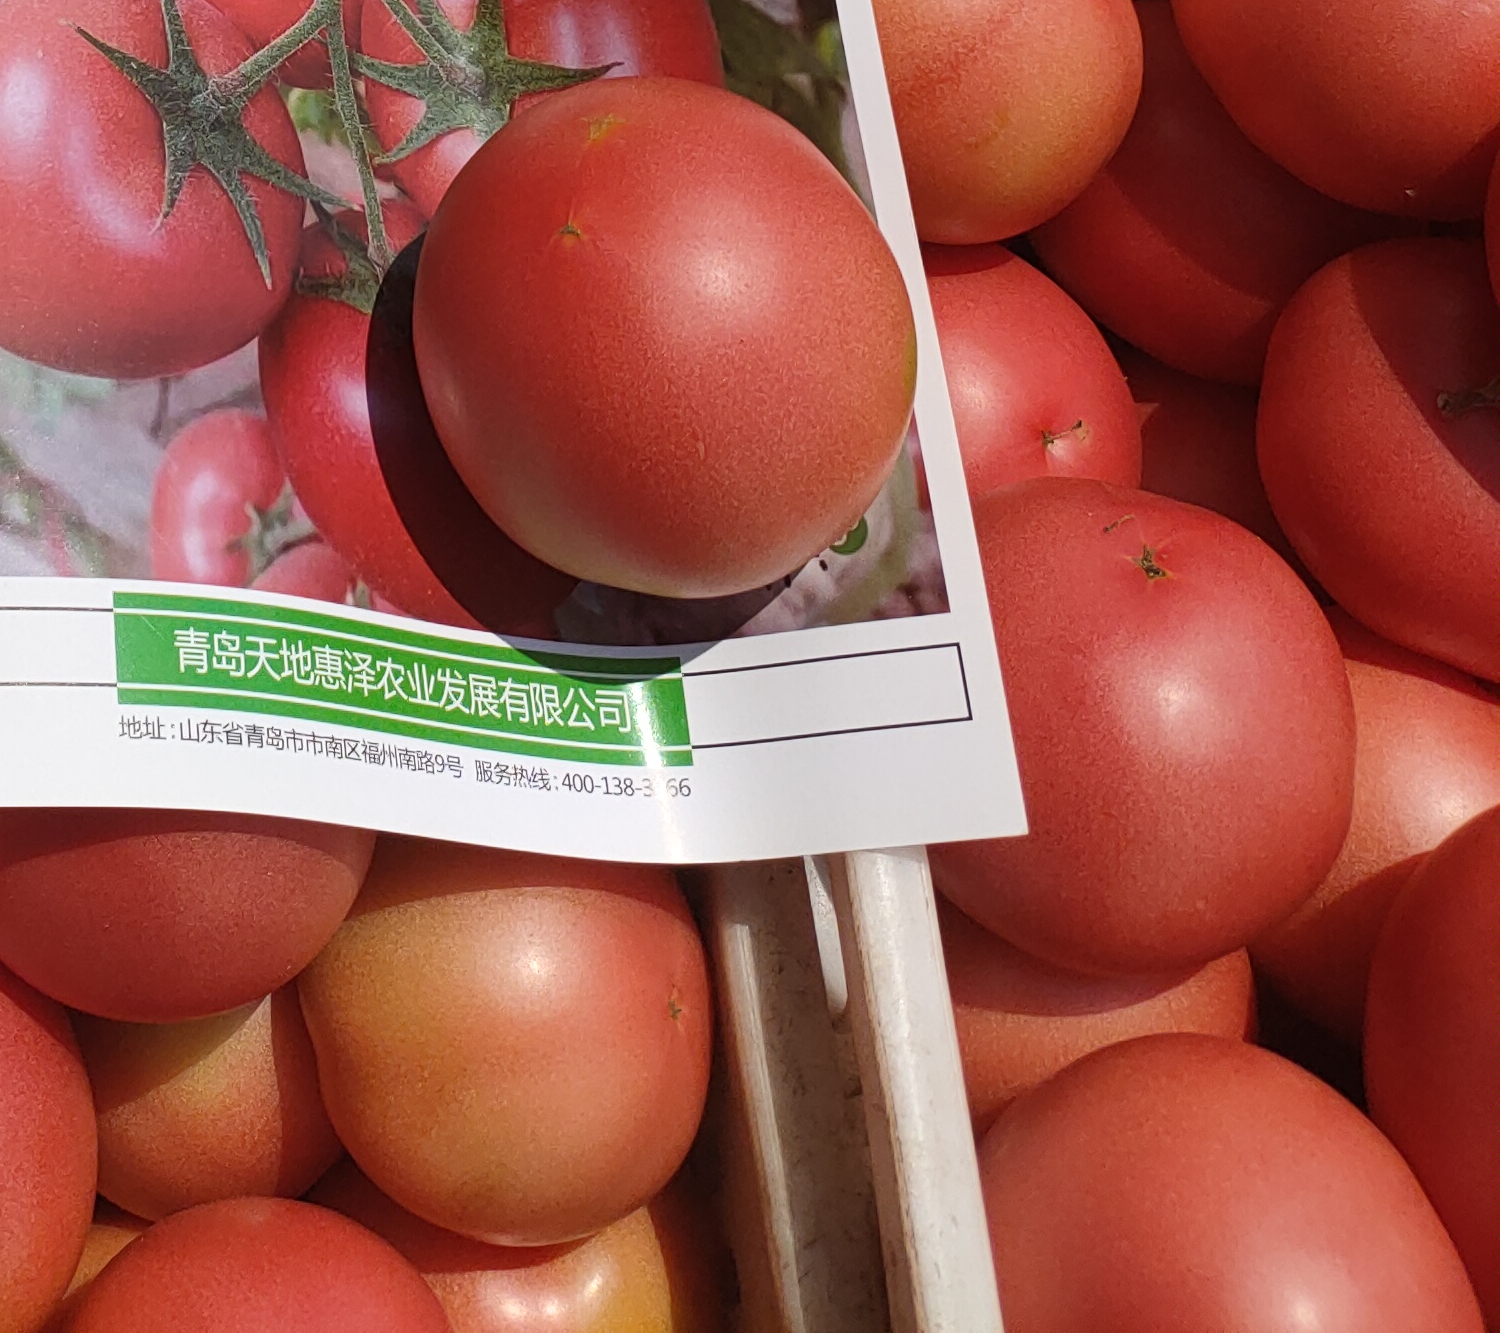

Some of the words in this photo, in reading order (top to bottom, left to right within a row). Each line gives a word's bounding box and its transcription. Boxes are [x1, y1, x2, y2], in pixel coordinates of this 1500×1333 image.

[172, 625, 632, 734] 青岛天地惠泽农业发展有限公司
[474, 758, 692, 798] 服务热线:400-138-366
